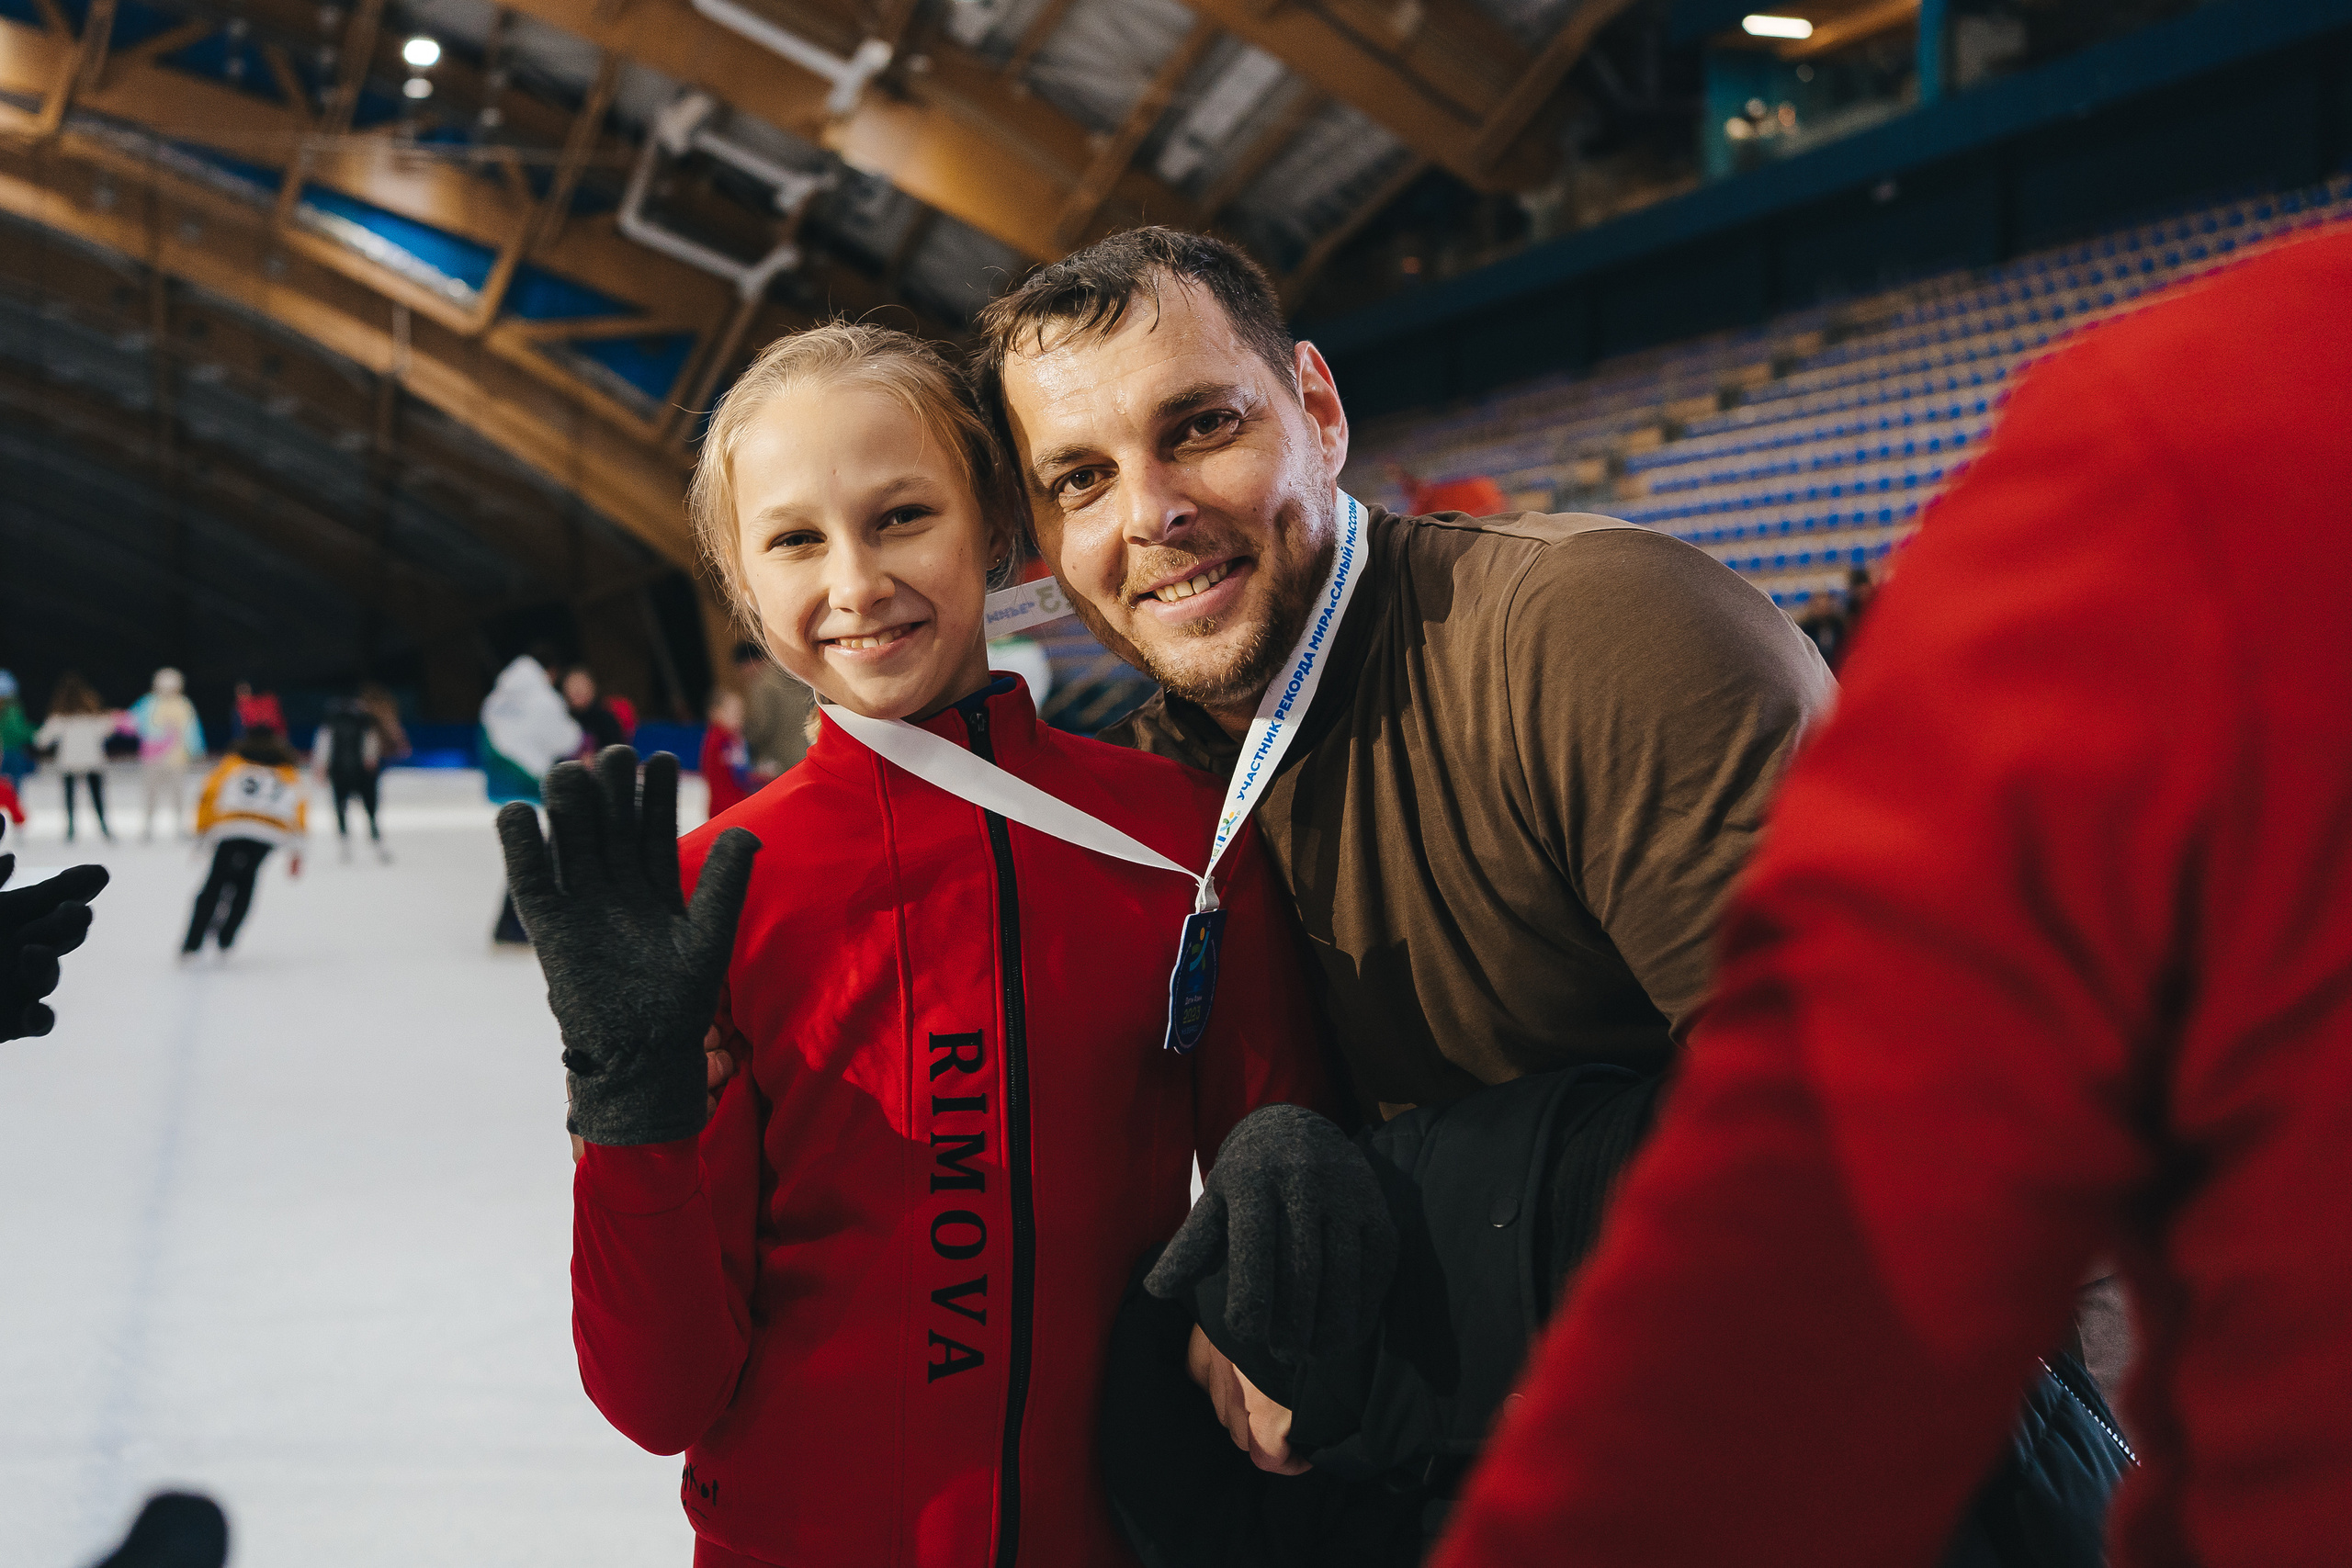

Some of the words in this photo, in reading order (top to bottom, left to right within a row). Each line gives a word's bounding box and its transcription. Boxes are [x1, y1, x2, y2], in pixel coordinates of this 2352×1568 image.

[1237, 720, 1283, 801] УЧАСТНИК
[1274, 651, 1317, 722] РЕКОРДА
[928, 1028, 989, 1384] RIMOVA
